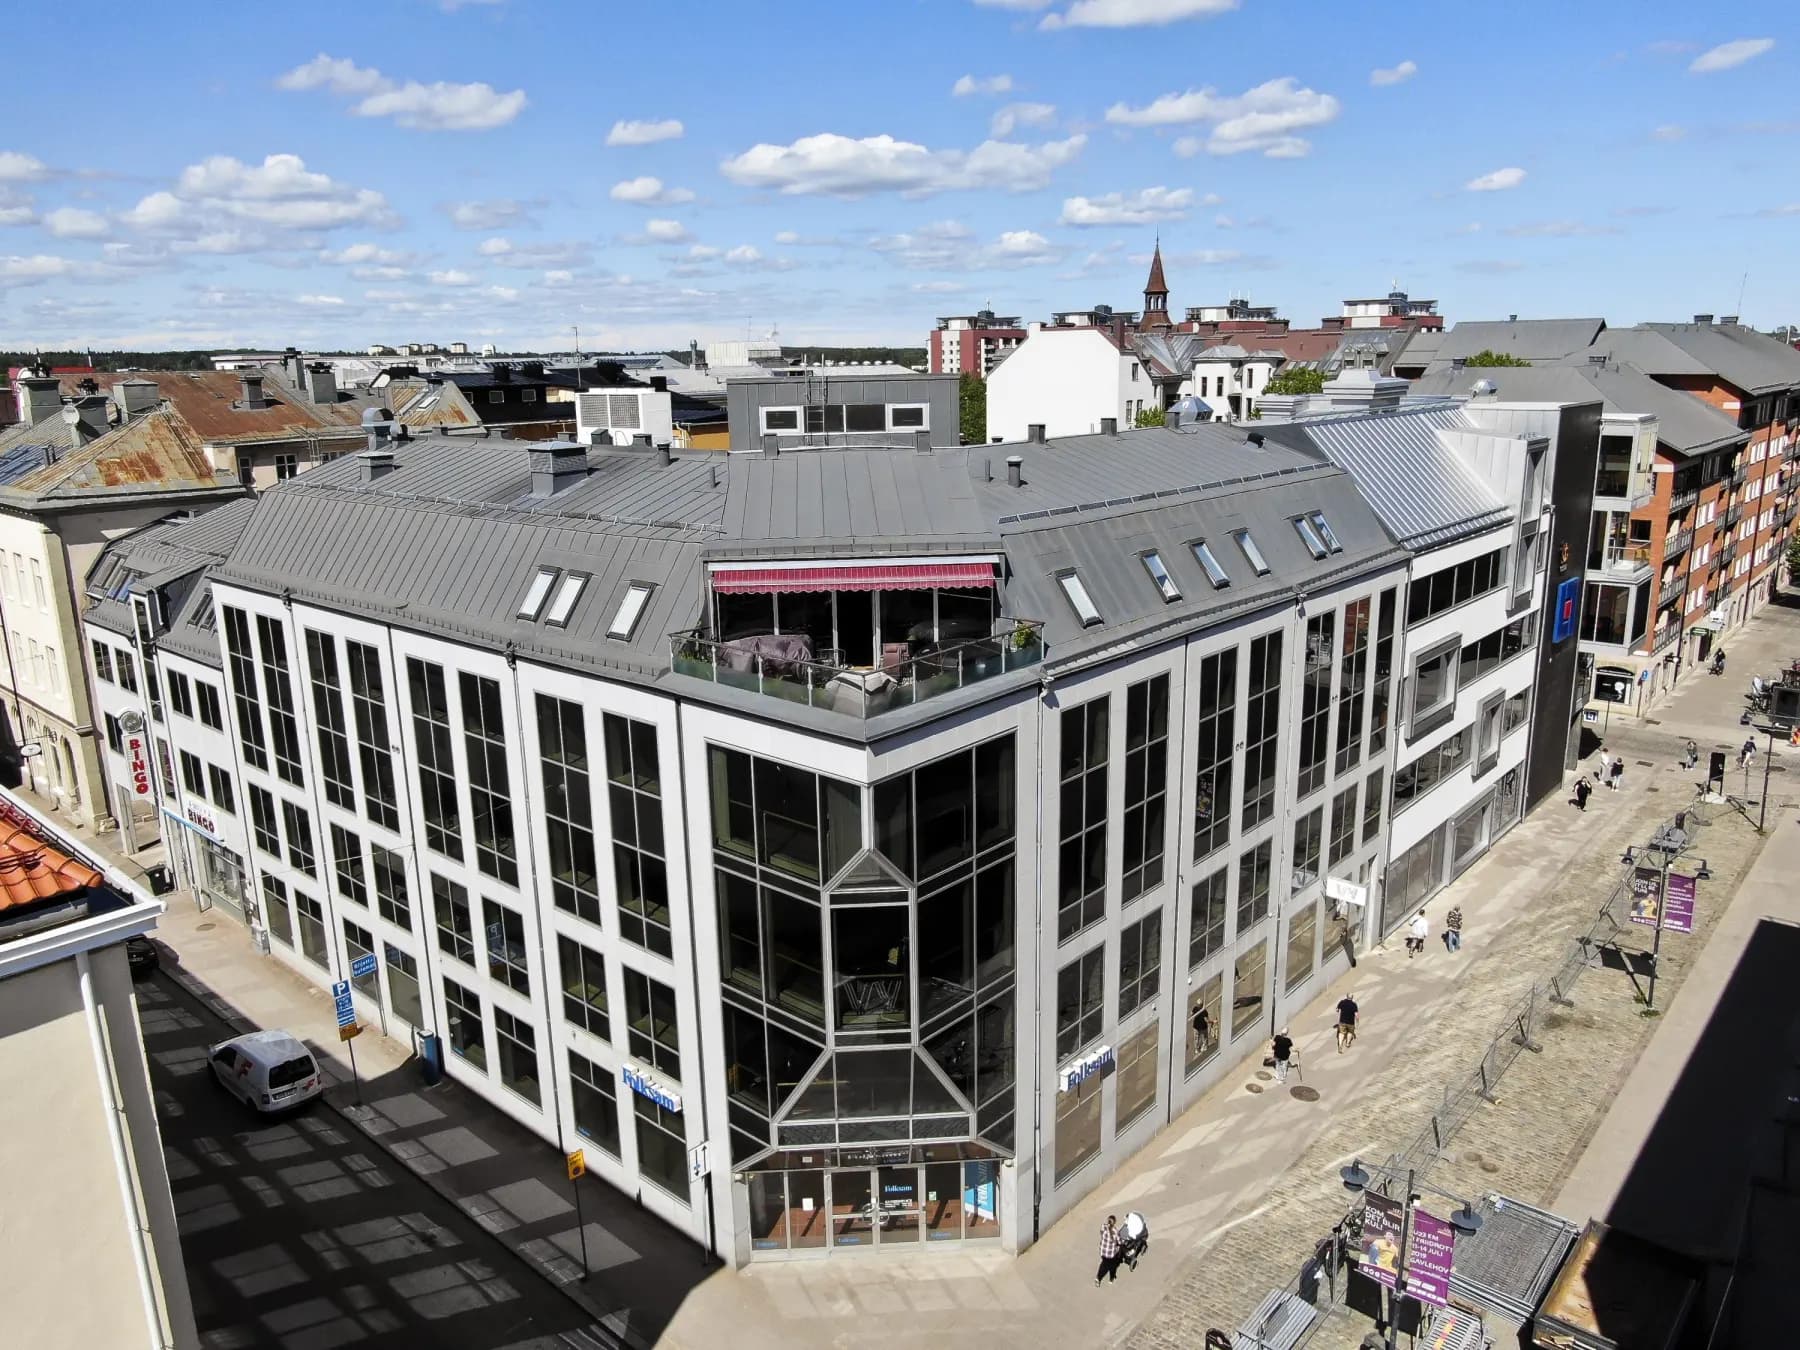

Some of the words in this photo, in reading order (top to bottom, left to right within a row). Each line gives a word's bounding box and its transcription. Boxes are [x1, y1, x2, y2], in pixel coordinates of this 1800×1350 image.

[129, 739, 149, 794] BINGO
[187, 807, 215, 833] BINGO
[336, 983, 346, 995] P
[1068, 1047, 1114, 1090] Folksam
[622, 1066, 676, 1112] Folksam
[1366, 1211, 1381, 1222] DET
[1383, 1217, 1401, 1232] BLIR
[1413, 1229, 1426, 1238] U23
[1428, 1233, 1439, 1241] EM
[1411, 1250, 1427, 1259] 2019
